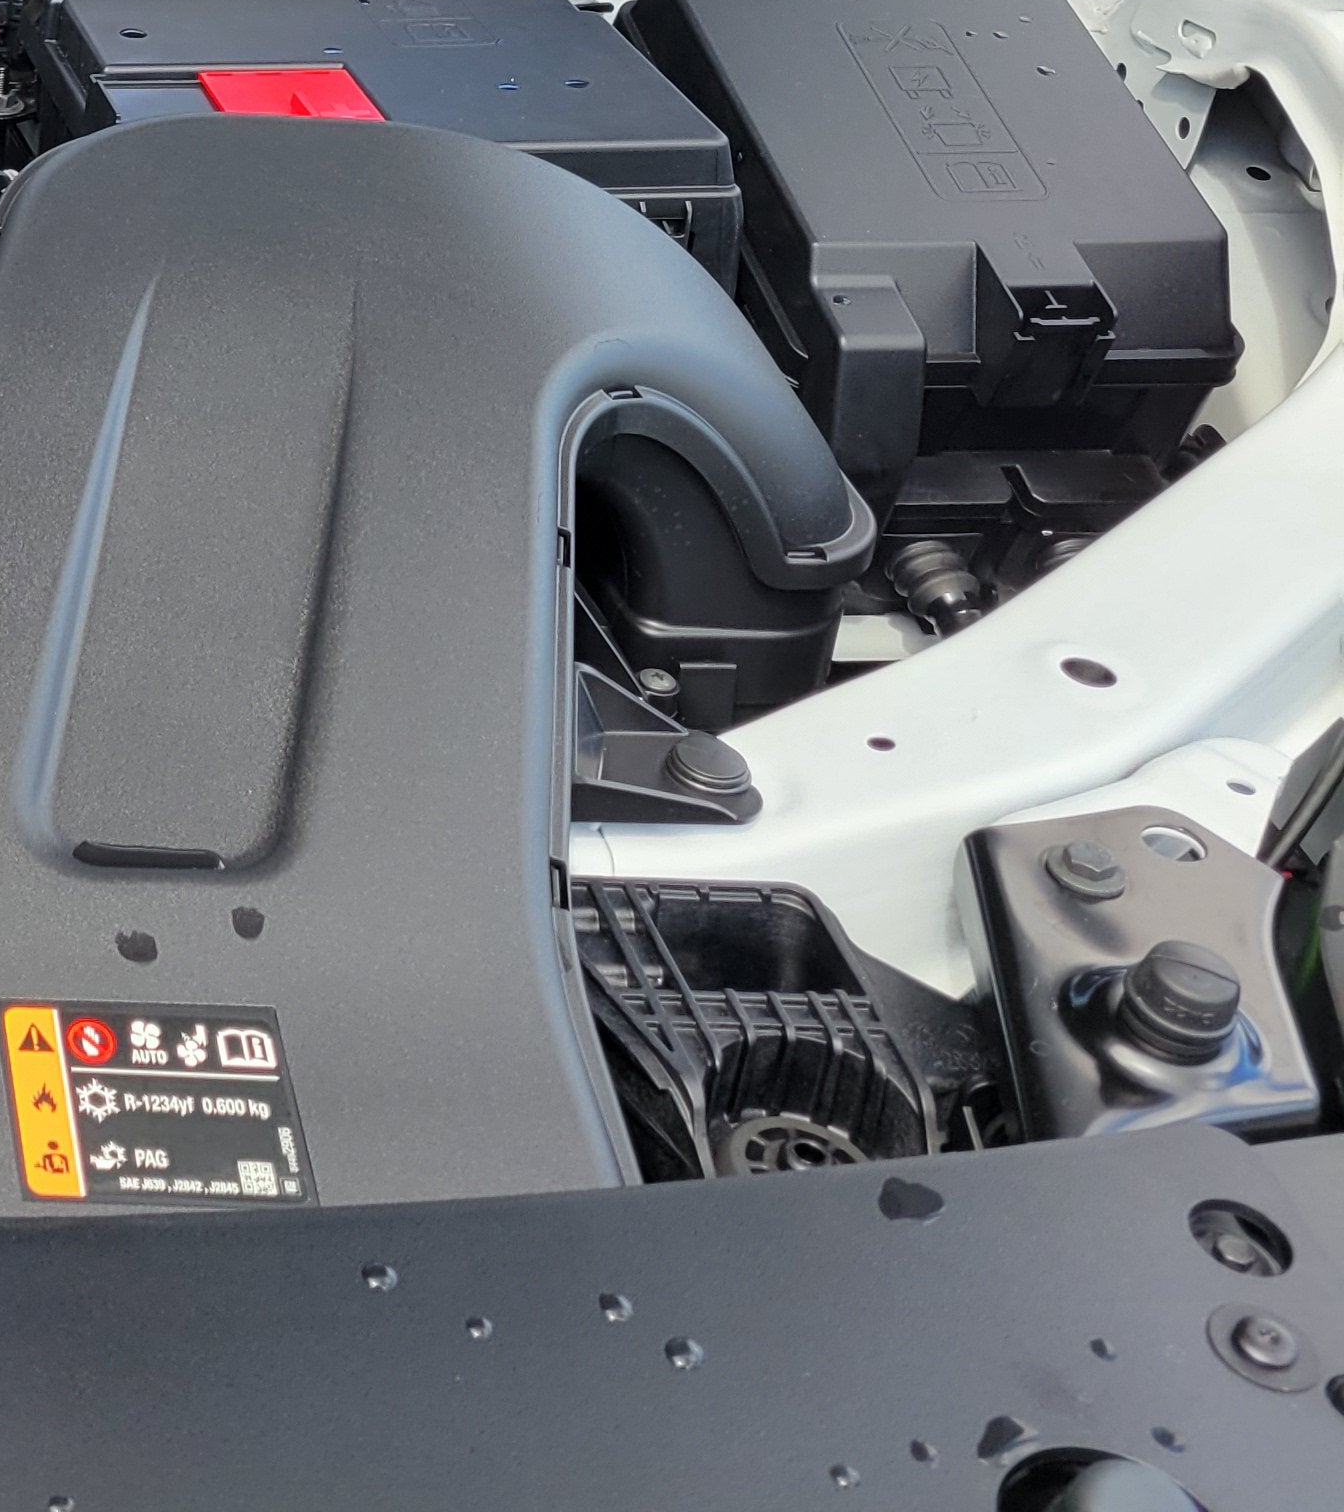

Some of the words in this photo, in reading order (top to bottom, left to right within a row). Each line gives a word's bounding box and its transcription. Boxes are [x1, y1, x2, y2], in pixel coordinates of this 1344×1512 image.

[132, 1049, 168, 1066] AUTO
[123, 1093, 195, 1117] R-1234yf
[201, 1096, 246, 1117] 0.600
[248, 1099, 272, 1120] kg
[134, 1148, 170, 1169] PAG
